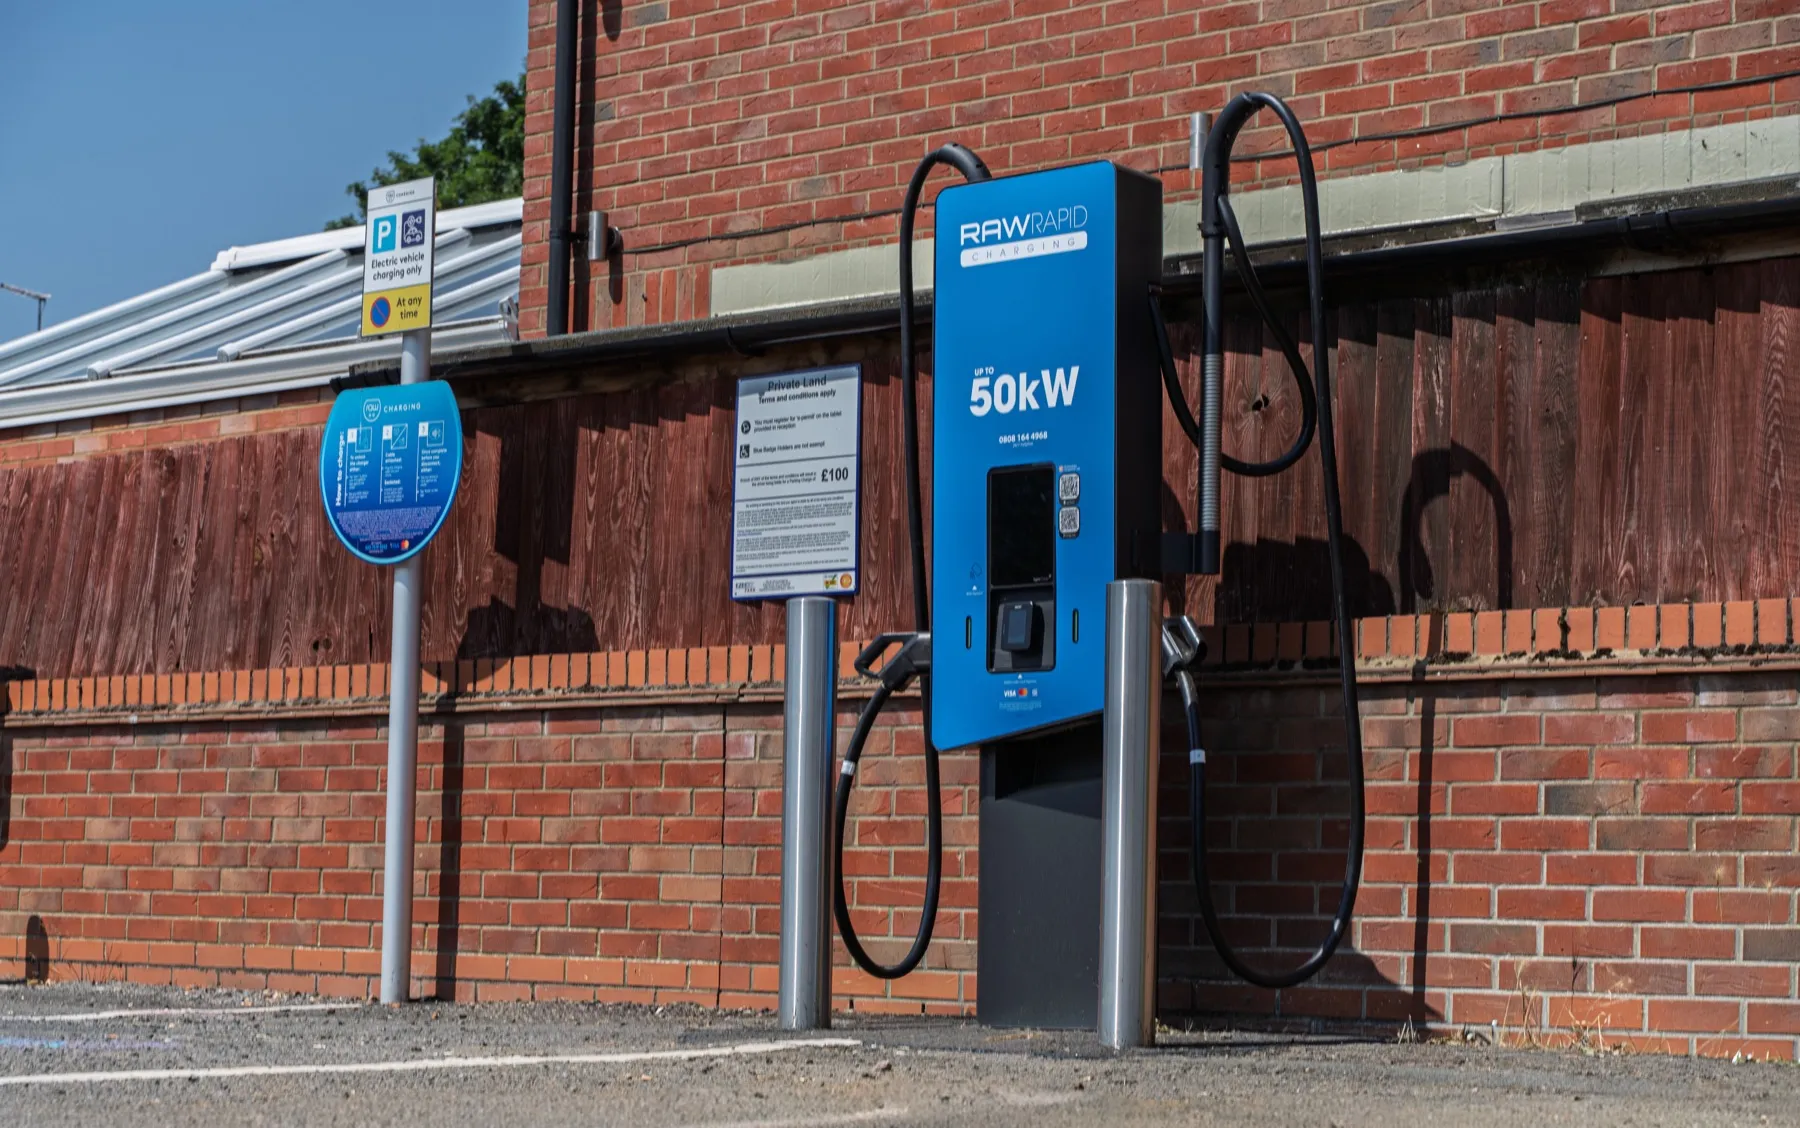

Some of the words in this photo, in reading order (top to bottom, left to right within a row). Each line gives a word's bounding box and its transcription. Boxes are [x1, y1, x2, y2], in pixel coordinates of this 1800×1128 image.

[378, 220, 392, 249] P
[972, 236, 1076, 262] CHARGING
[371, 256, 398, 269] Electric
[400, 251, 425, 264] vehicle
[372, 267, 404, 281] charging
[406, 264, 422, 278] only
[396, 297, 406, 308] At
[408, 296, 422, 307] any
[400, 309, 418, 320] time
[974, 367, 984, 376] UP
[985, 366, 995, 375] TO
[768, 378, 801, 391] Private
[803, 376, 827, 388] Land
[969, 365, 1080, 417] 50kW
[759, 396, 775, 404] Terms
[776, 394, 787, 402] and
[788, 391, 819, 401] conditions
[820, 389, 836, 398] apply
[383, 402, 421, 413] CHARGING
[998, 434, 1016, 444] 0808
[1017, 432, 1030, 442] 164
[337, 470, 343, 480] to
[821, 466, 849, 482] £100
[335, 486, 343, 506] How
[1004, 689, 1017, 698] VISA
